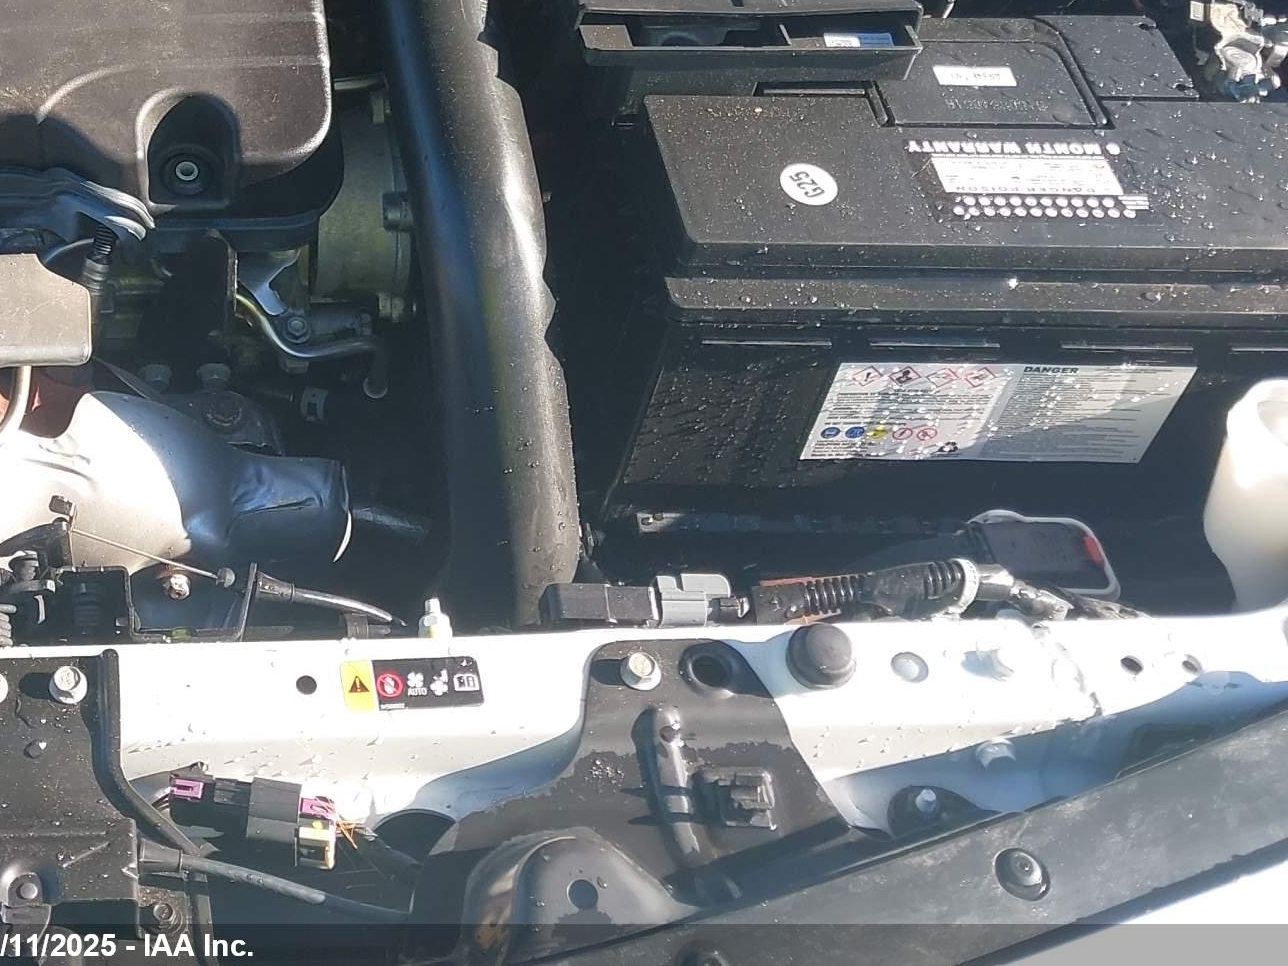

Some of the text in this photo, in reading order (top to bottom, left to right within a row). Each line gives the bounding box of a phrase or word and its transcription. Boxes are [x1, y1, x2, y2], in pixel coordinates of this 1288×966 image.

[907, 140, 1023, 155] WARRANTY
[1025, 141, 1102, 155] MONTH
[788, 170, 825, 199] G25
[1023, 366, 1079, 374] DANGER
[407, 687, 428, 696] AUTO
